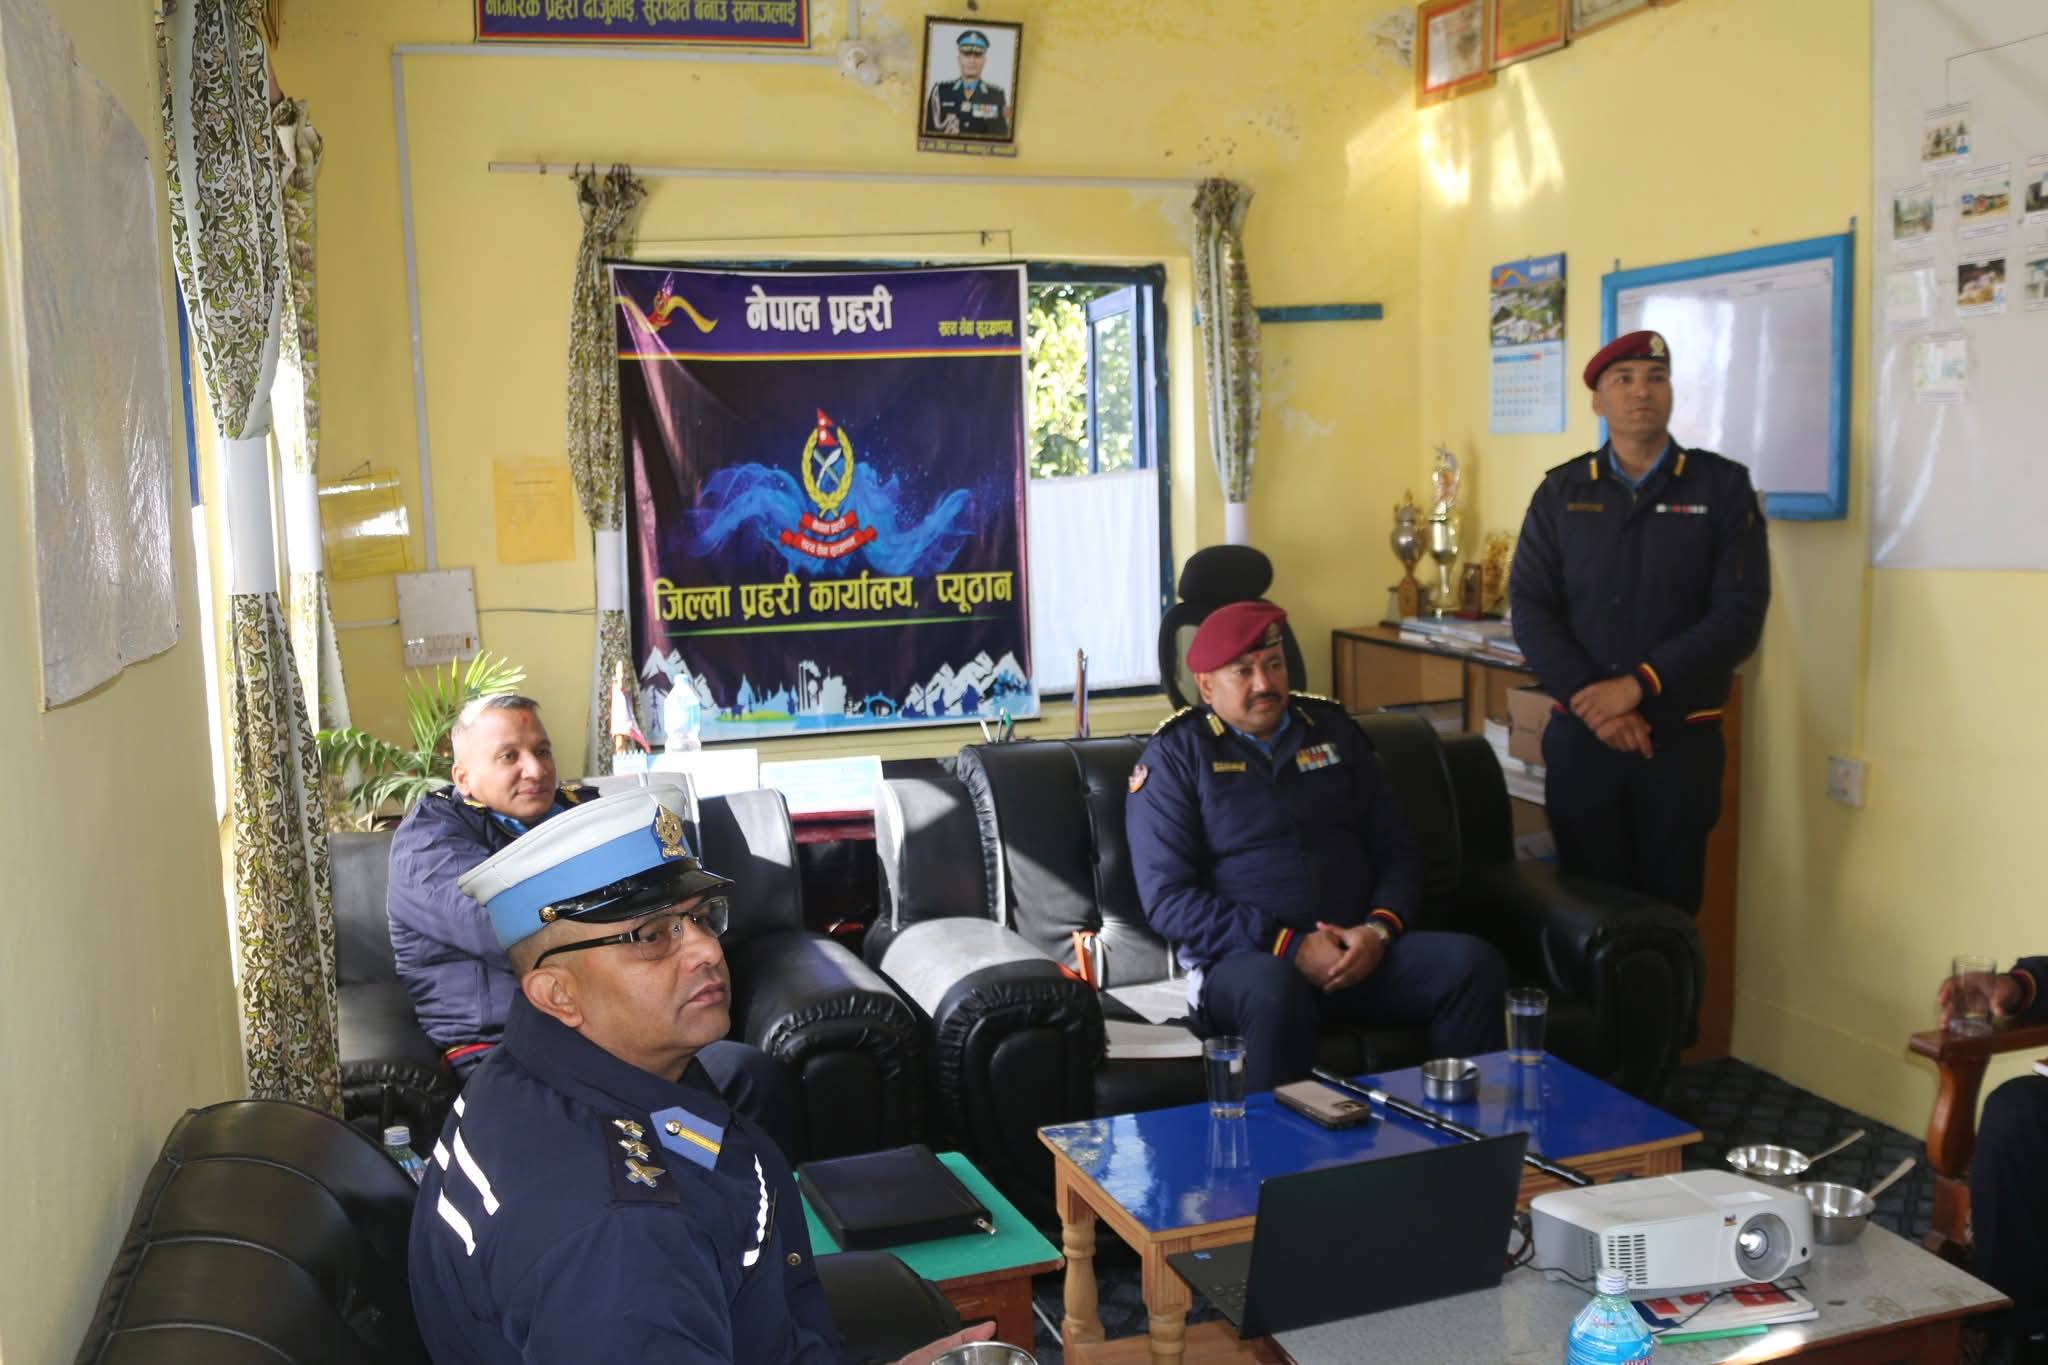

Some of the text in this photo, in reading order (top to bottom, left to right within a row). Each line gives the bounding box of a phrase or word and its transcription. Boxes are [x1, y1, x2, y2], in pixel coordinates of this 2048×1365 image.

[745, 284, 893, 335] नेपाल प्रहरी
[653, 570, 1013, 622] जिल्ला प्रहरी कार्यालय, प्यूठान
